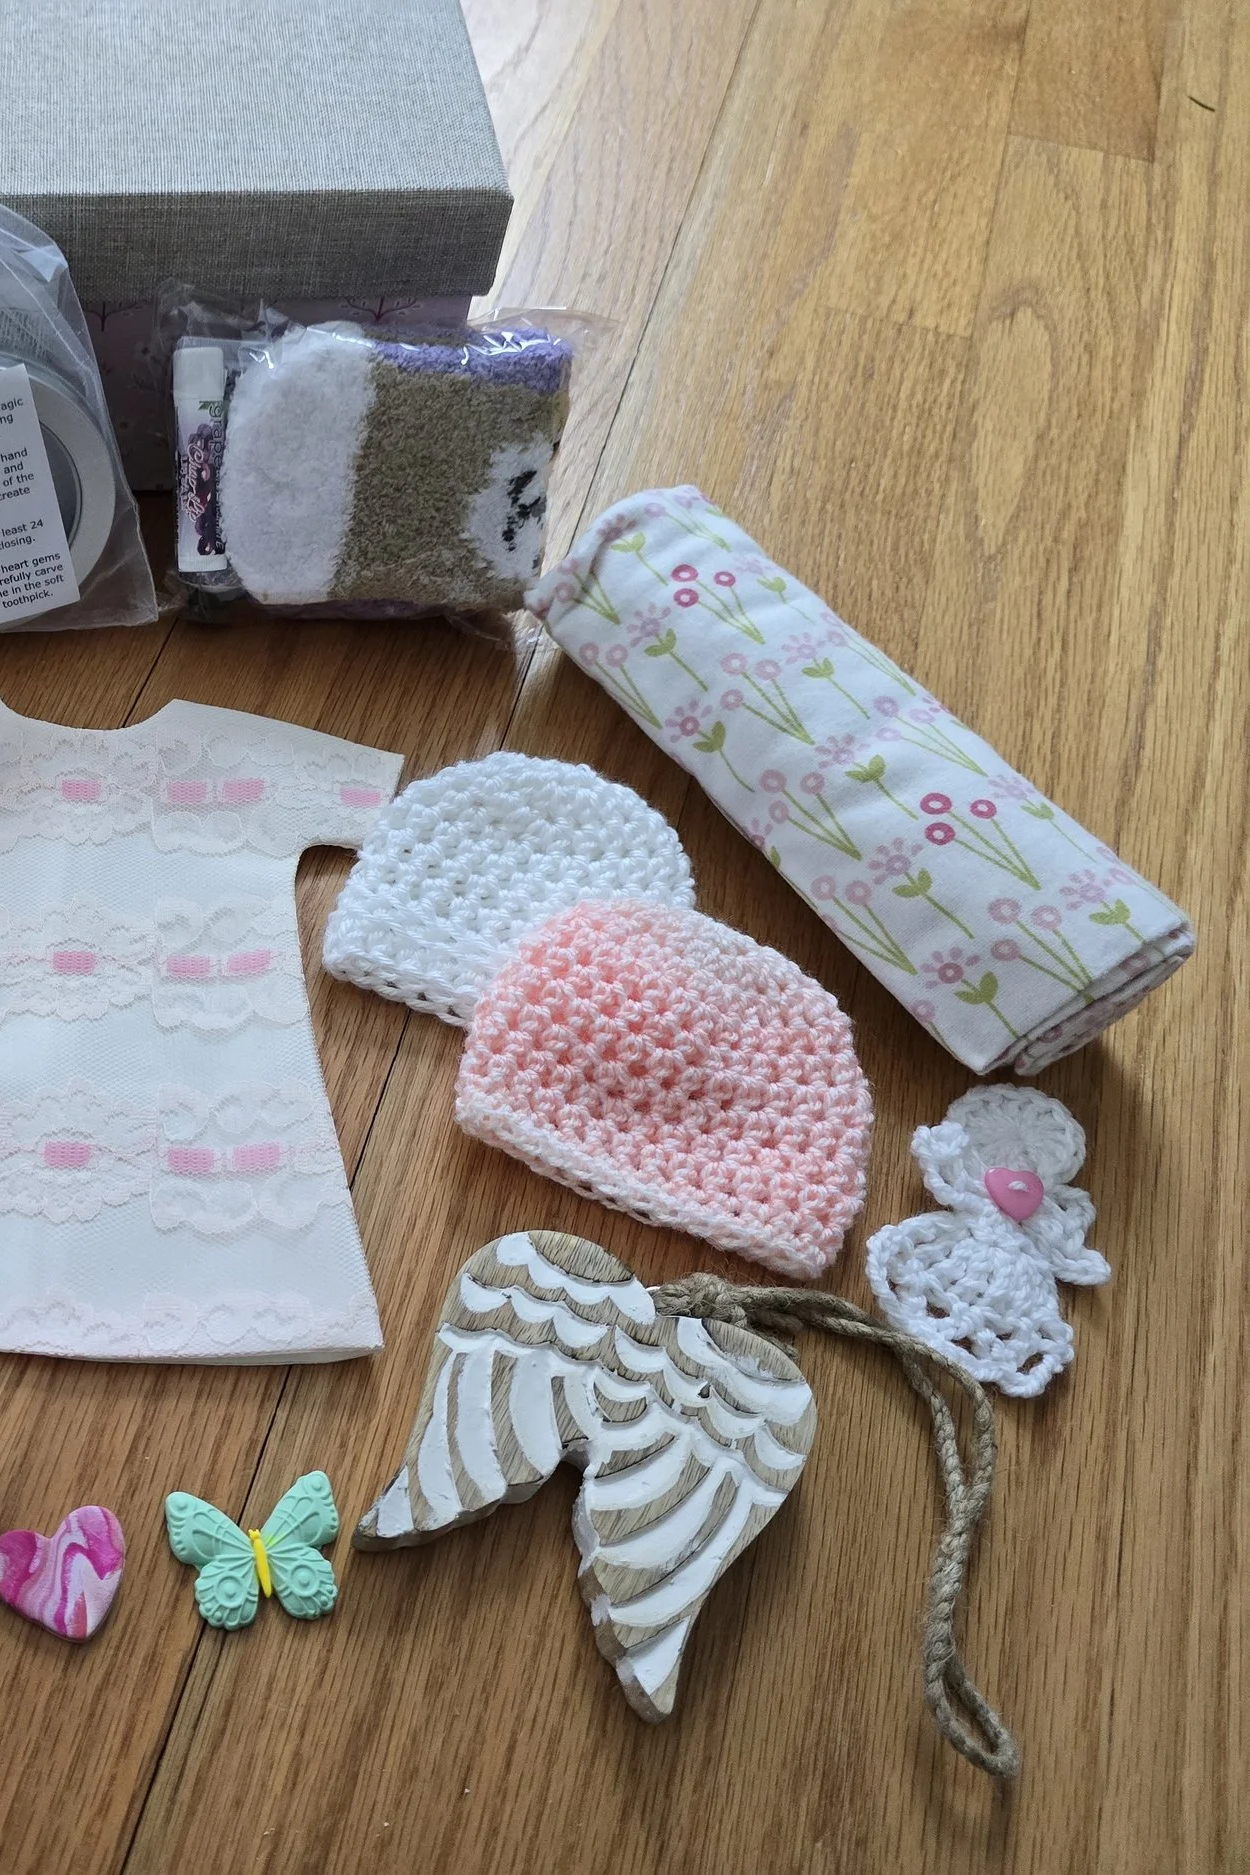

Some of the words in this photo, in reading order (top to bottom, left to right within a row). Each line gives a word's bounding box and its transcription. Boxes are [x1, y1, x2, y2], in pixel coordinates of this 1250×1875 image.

[0, 446, 28, 463] hand
[1, 523, 28, 538] least
[29, 518, 44, 530] 24
[0, 559, 30, 574] heart
[31, 552, 61, 568] gems
